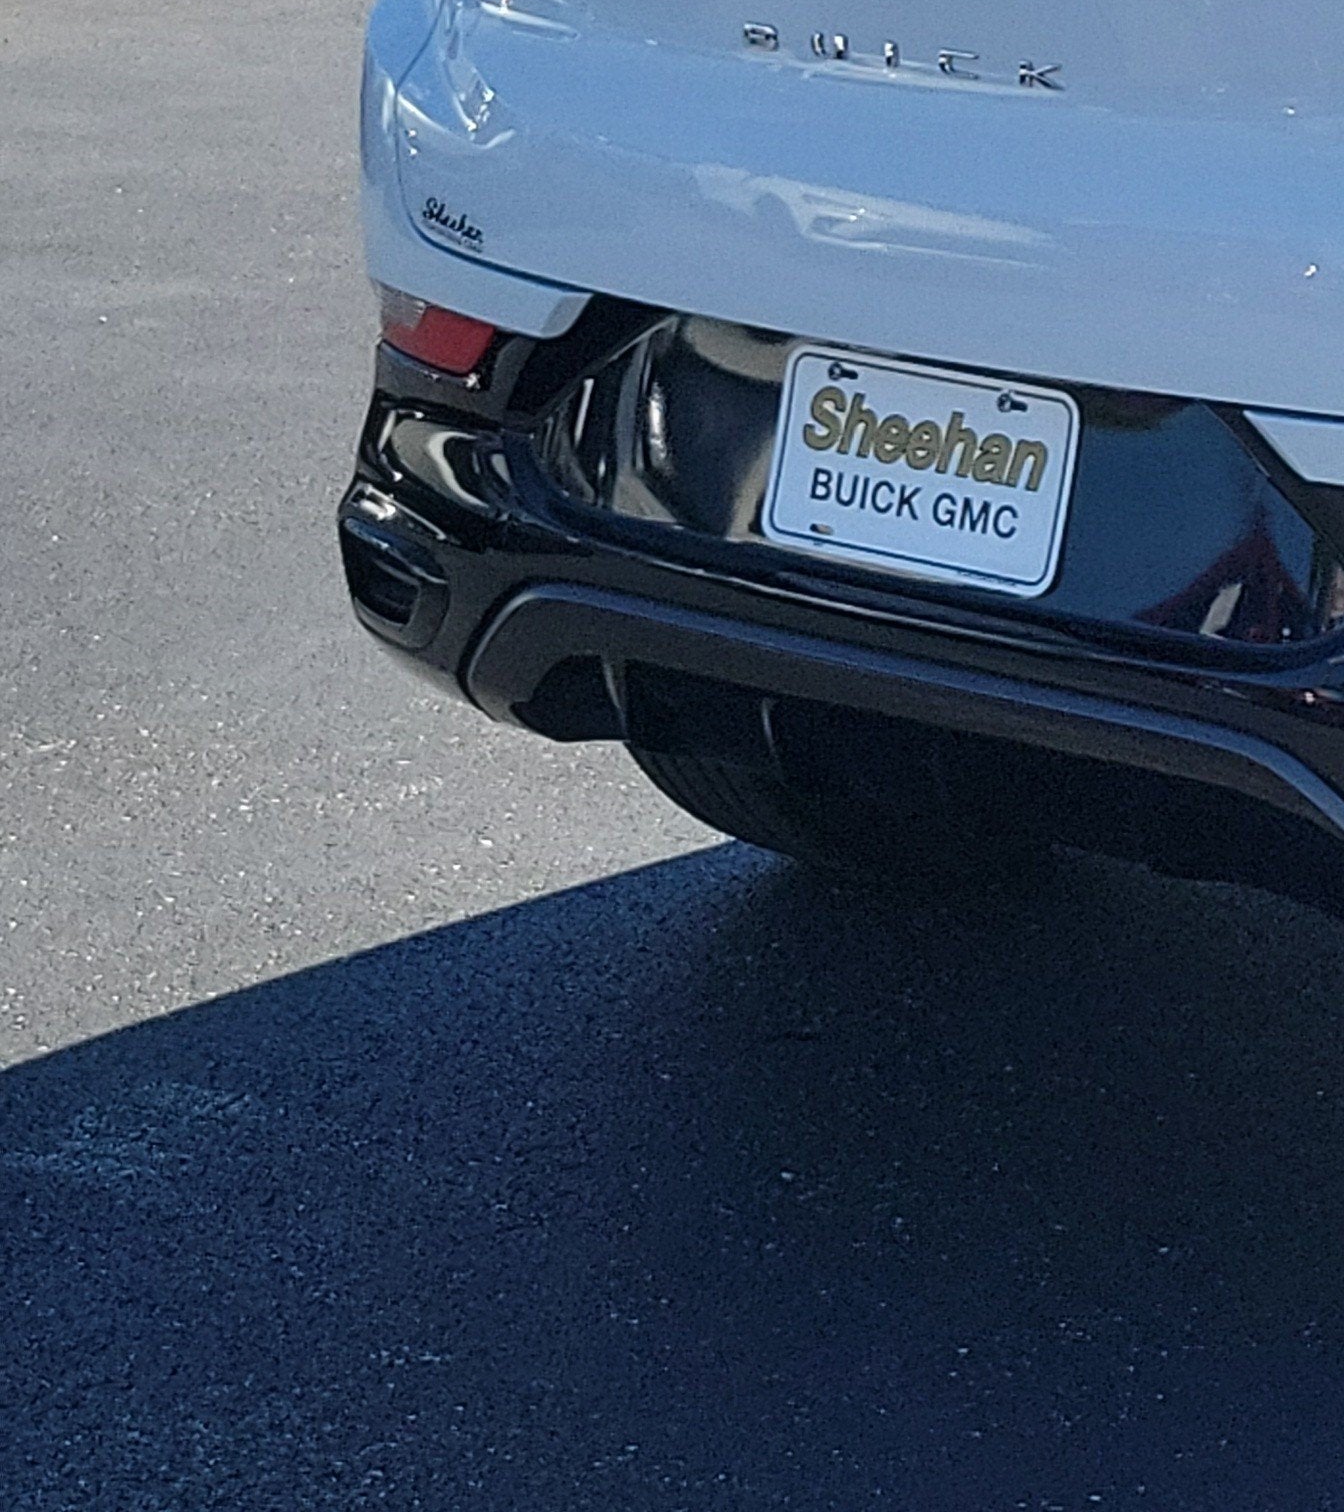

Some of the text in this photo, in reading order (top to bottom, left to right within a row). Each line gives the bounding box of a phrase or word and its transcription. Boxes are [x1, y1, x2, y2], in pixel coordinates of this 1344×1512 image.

[742, 20, 1065, 91] BUICK
[803, 386, 1048, 492] Sheehan
[809, 467, 1020, 539] BUICK GMC
